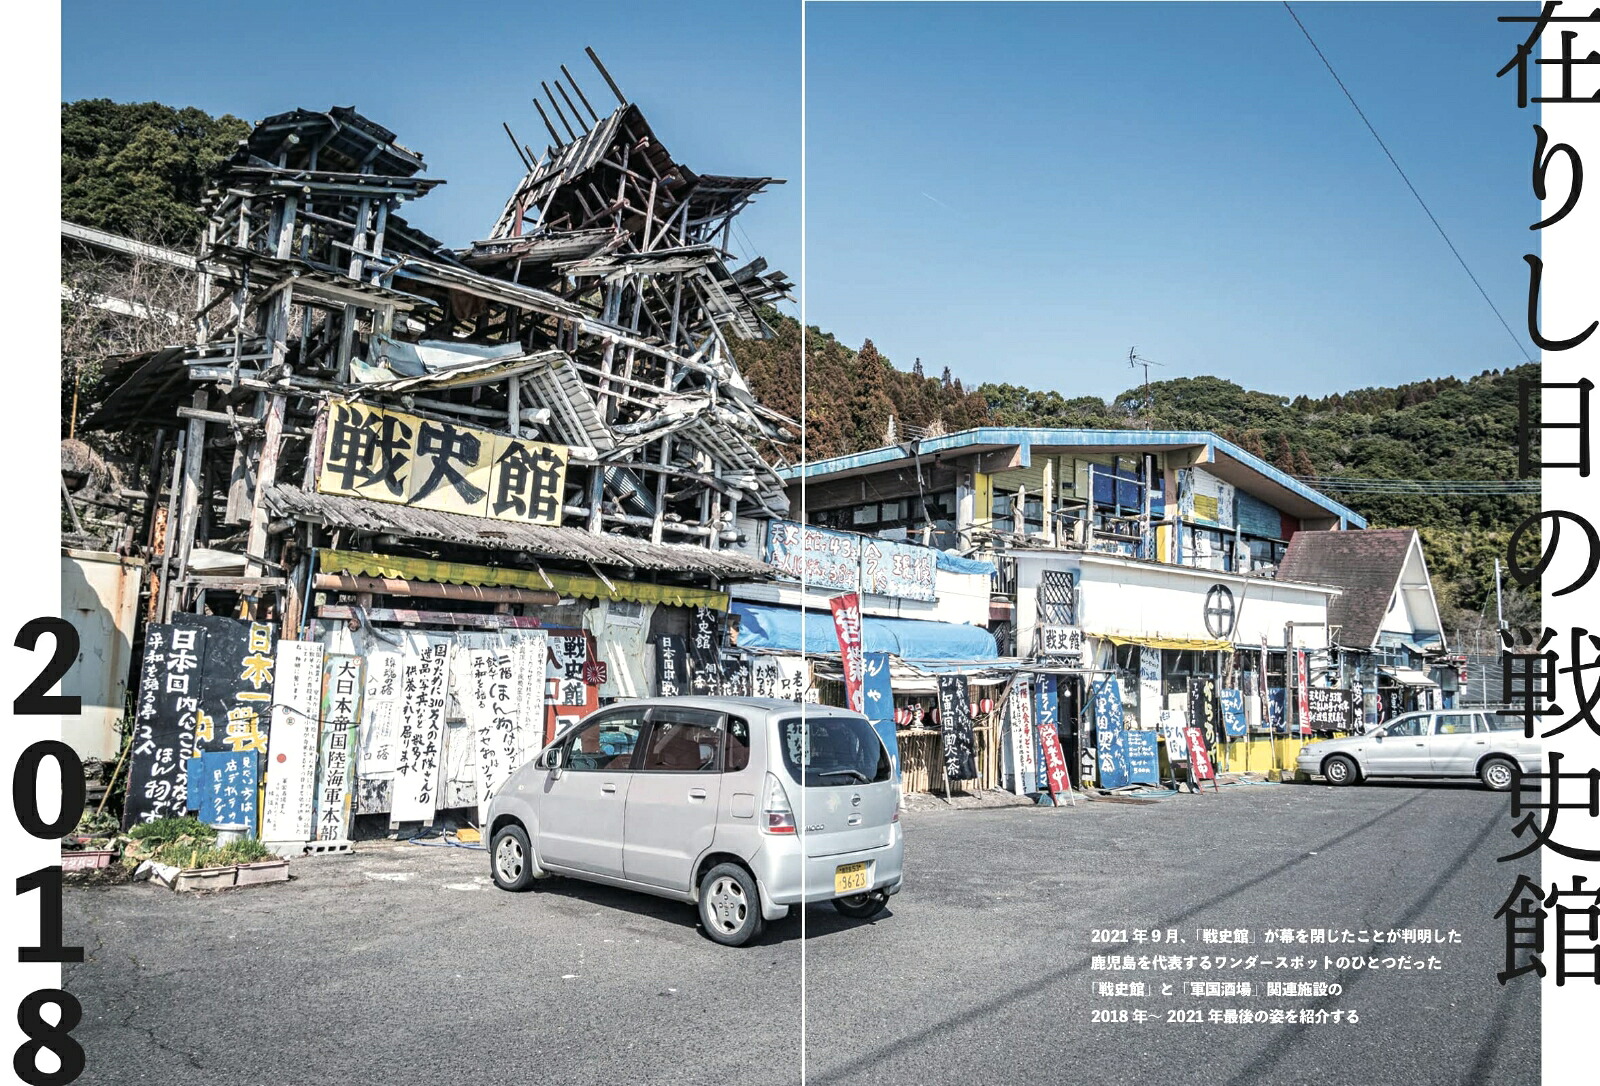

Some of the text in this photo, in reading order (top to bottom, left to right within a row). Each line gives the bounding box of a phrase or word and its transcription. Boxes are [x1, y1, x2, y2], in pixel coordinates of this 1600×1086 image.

[326, 404, 565, 522] 戦史館
[562, 636, 586, 707] 戦史館
[1045, 629, 1080, 651] 戦史館
[320, 661, 356, 840] 大日本帝国陸海軍本部
[942, 691, 960, 776] 軍国喫茶
[1081, 748, 1095, 776] 入口
